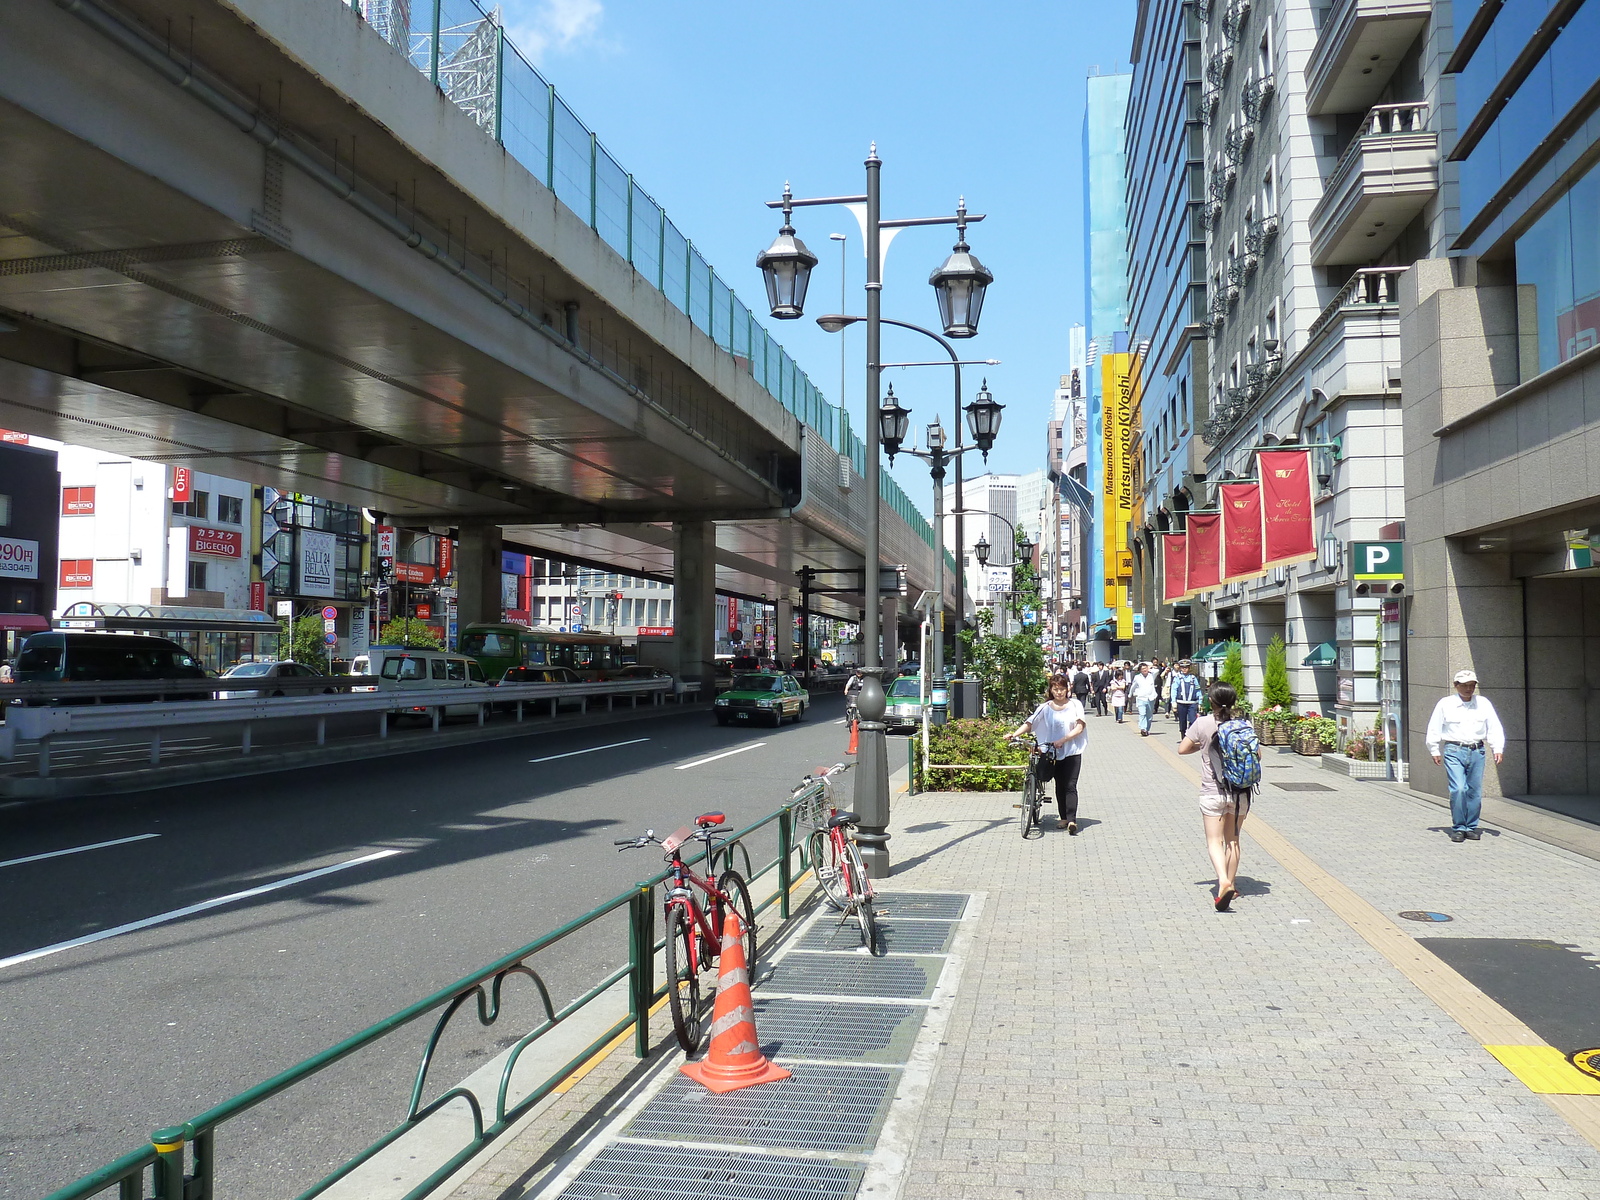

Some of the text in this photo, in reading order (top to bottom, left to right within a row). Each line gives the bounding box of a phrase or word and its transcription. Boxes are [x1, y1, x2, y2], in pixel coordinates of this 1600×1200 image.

[1118, 375, 1131, 510] Matsumoto KiYoshi
[1104, 406, 1113, 496] Matsumoto KiYoshi
[1276, 499, 1302, 508] Hotel
[198, 528, 234, 540] カラオケ
[305, 550, 330, 565] BALI 24
[1366, 546, 1390, 573] P
[305, 562, 330, 576] RELAX
[354, 611, 363, 619] 24
